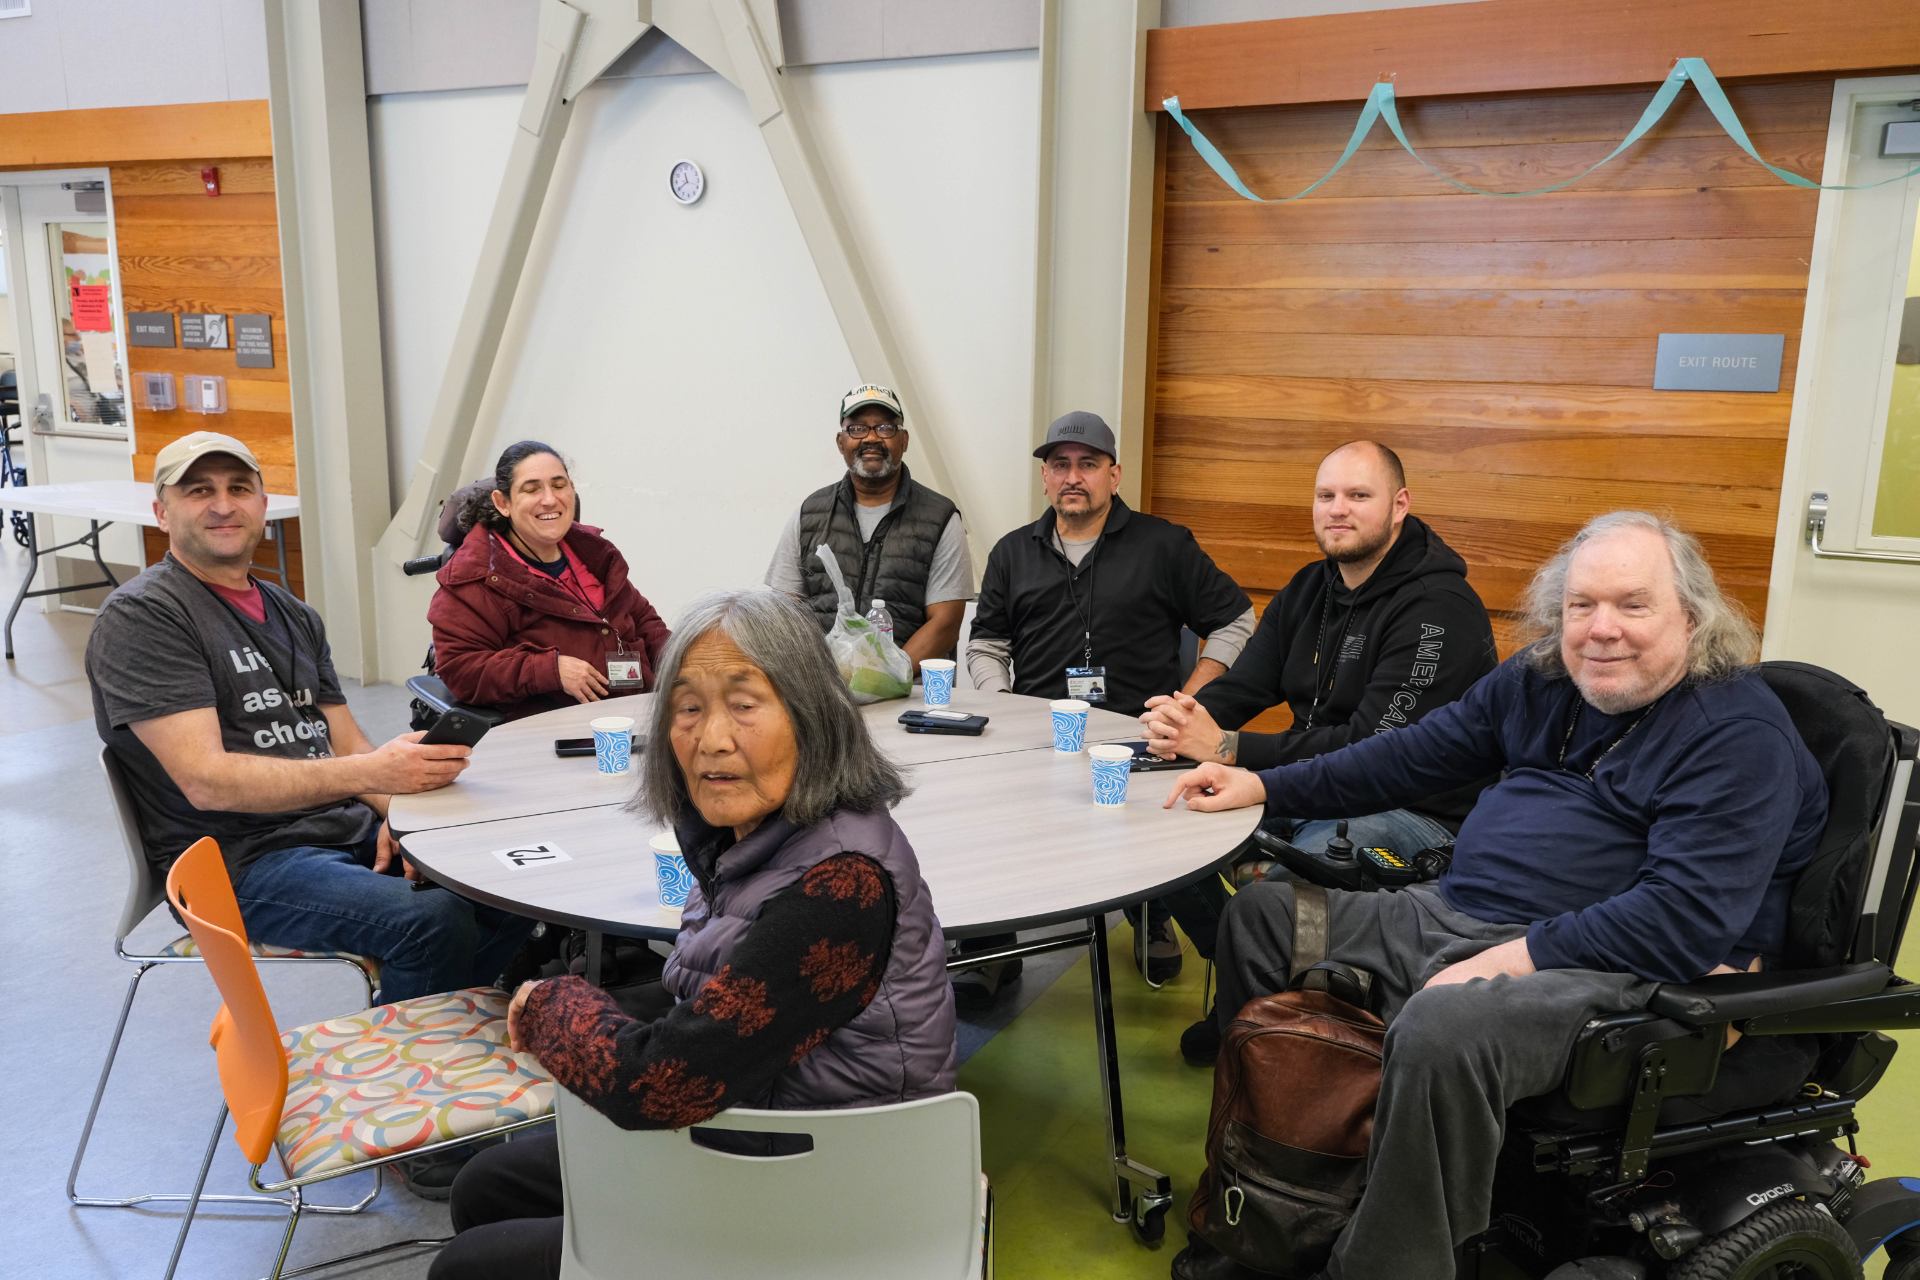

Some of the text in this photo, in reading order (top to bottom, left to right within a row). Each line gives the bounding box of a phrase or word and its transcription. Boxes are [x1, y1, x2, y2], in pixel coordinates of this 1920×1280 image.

[1678, 356, 1758, 369] EXIT ROUTE
[229, 646, 273, 673] Li
[242, 687, 283, 713] as
